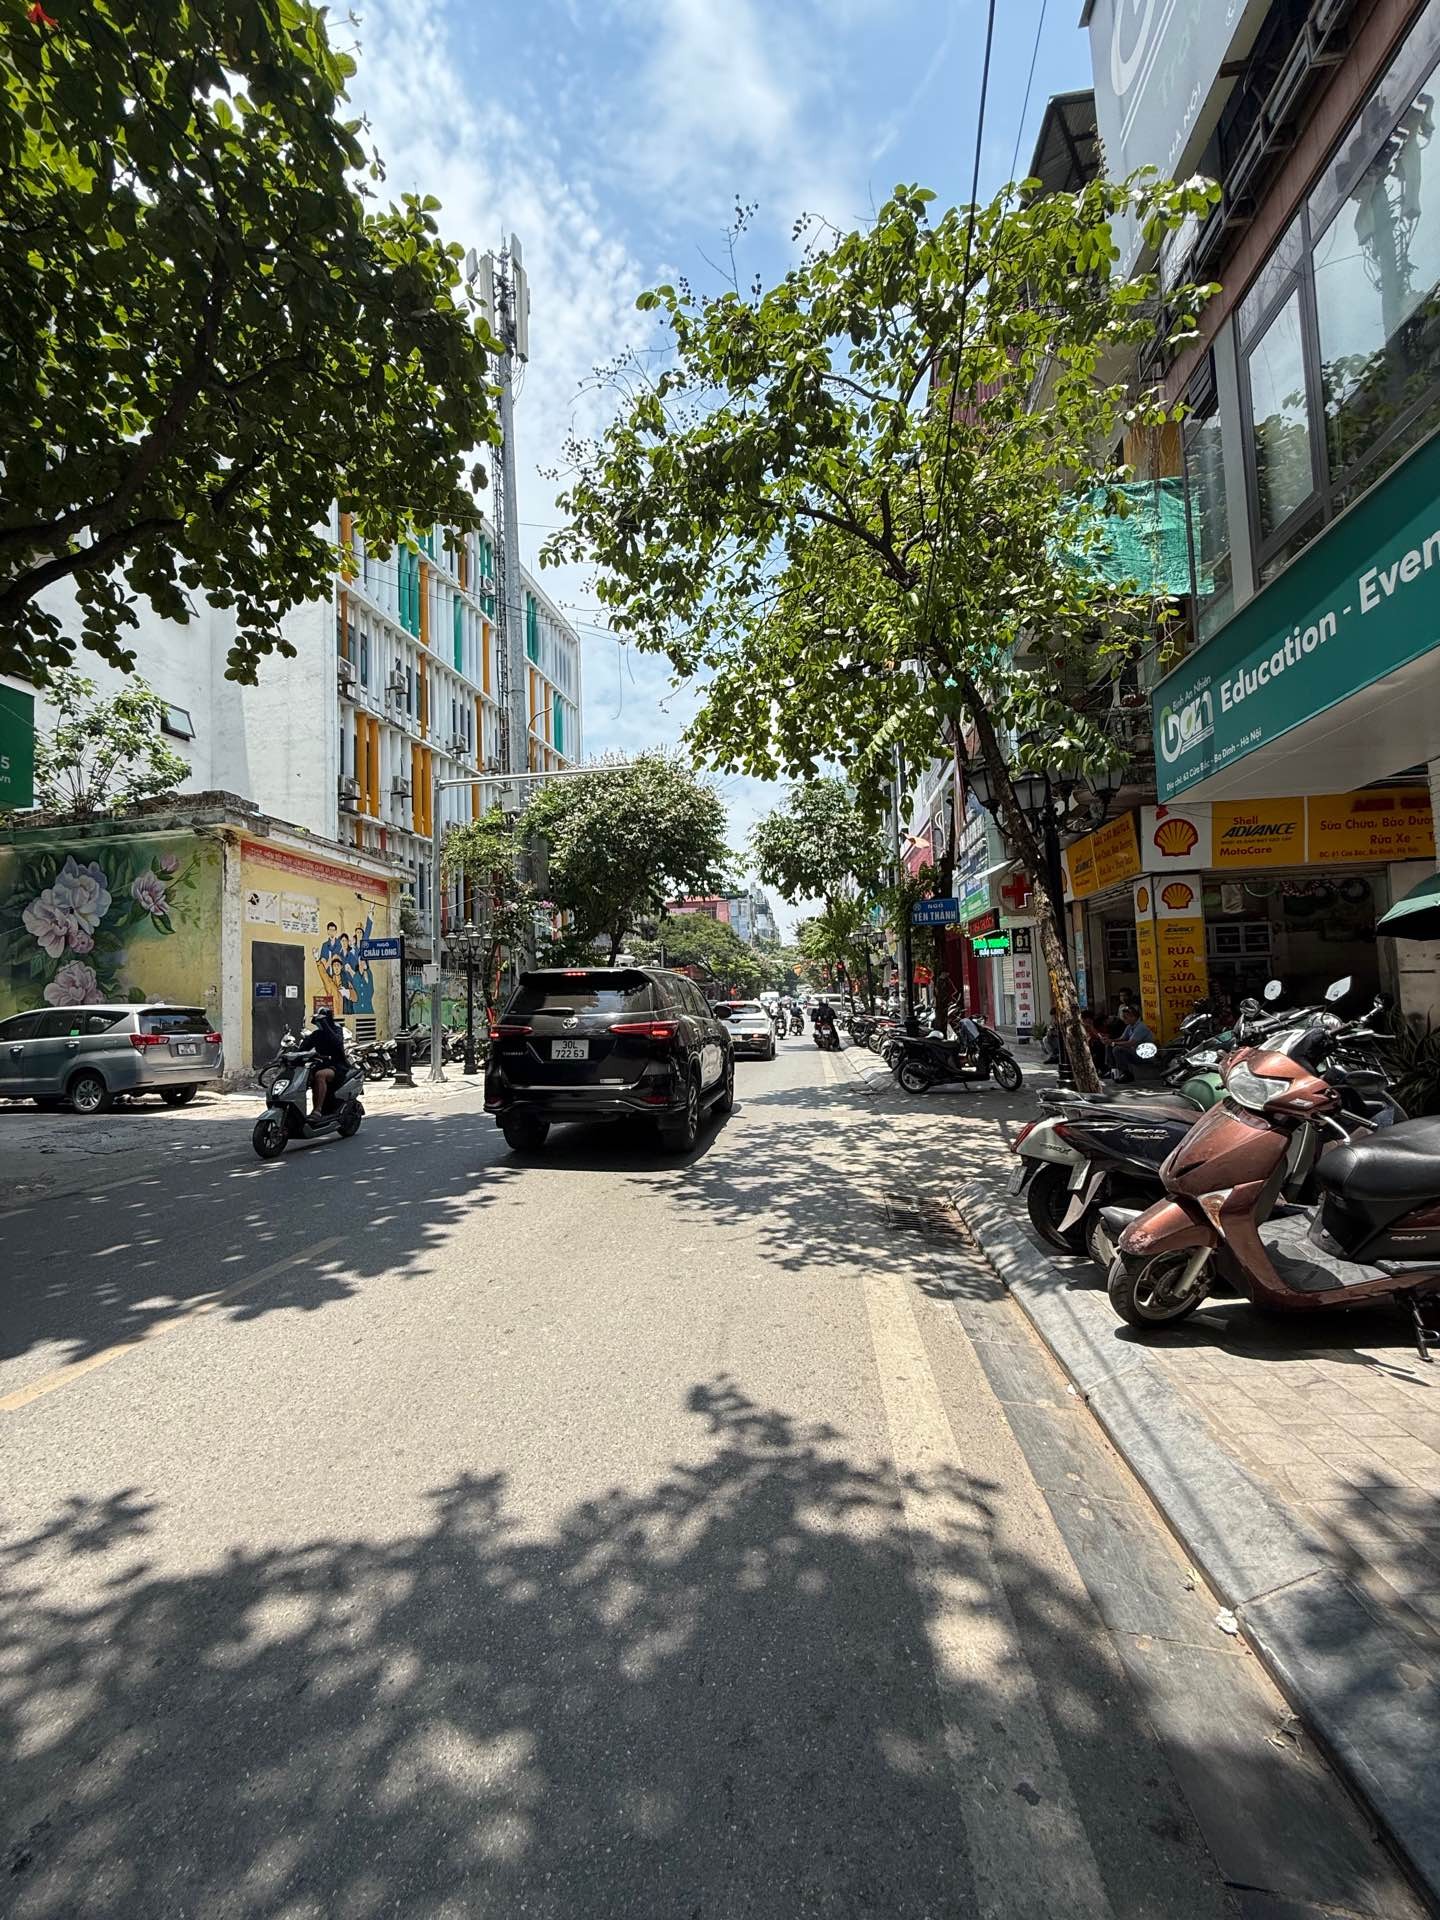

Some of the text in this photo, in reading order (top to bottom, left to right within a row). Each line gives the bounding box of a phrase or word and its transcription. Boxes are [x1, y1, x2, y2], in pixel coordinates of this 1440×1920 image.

[1220, 610, 1337, 713] Education
[1183, 772, 1190, 782] 63
[1214, 753, 1222, 764] Ba
[1240, 737, 1250, 748] Hà
[1250, 727, 1262, 742] Nội
[1233, 816, 1258, 825] Shell
[1222, 822, 1297, 839] ADVANCE
[1395, 832, 1410, 843] Xe
[1220, 846, 1273, 857] MotoCare
[913, 910, 956, 922] YÊN THÀNH
[1016, 935, 1030, 947] 61
[363, 947, 397, 957] CHÂU LONG
[1167, 943, 1195, 955] RỬA
[1172, 960, 1189, 968] XE
[1167, 970, 1195, 981] SỬA
[1167, 999, 1194, 1009] THA
[562, 1040, 578, 1049] 30L
